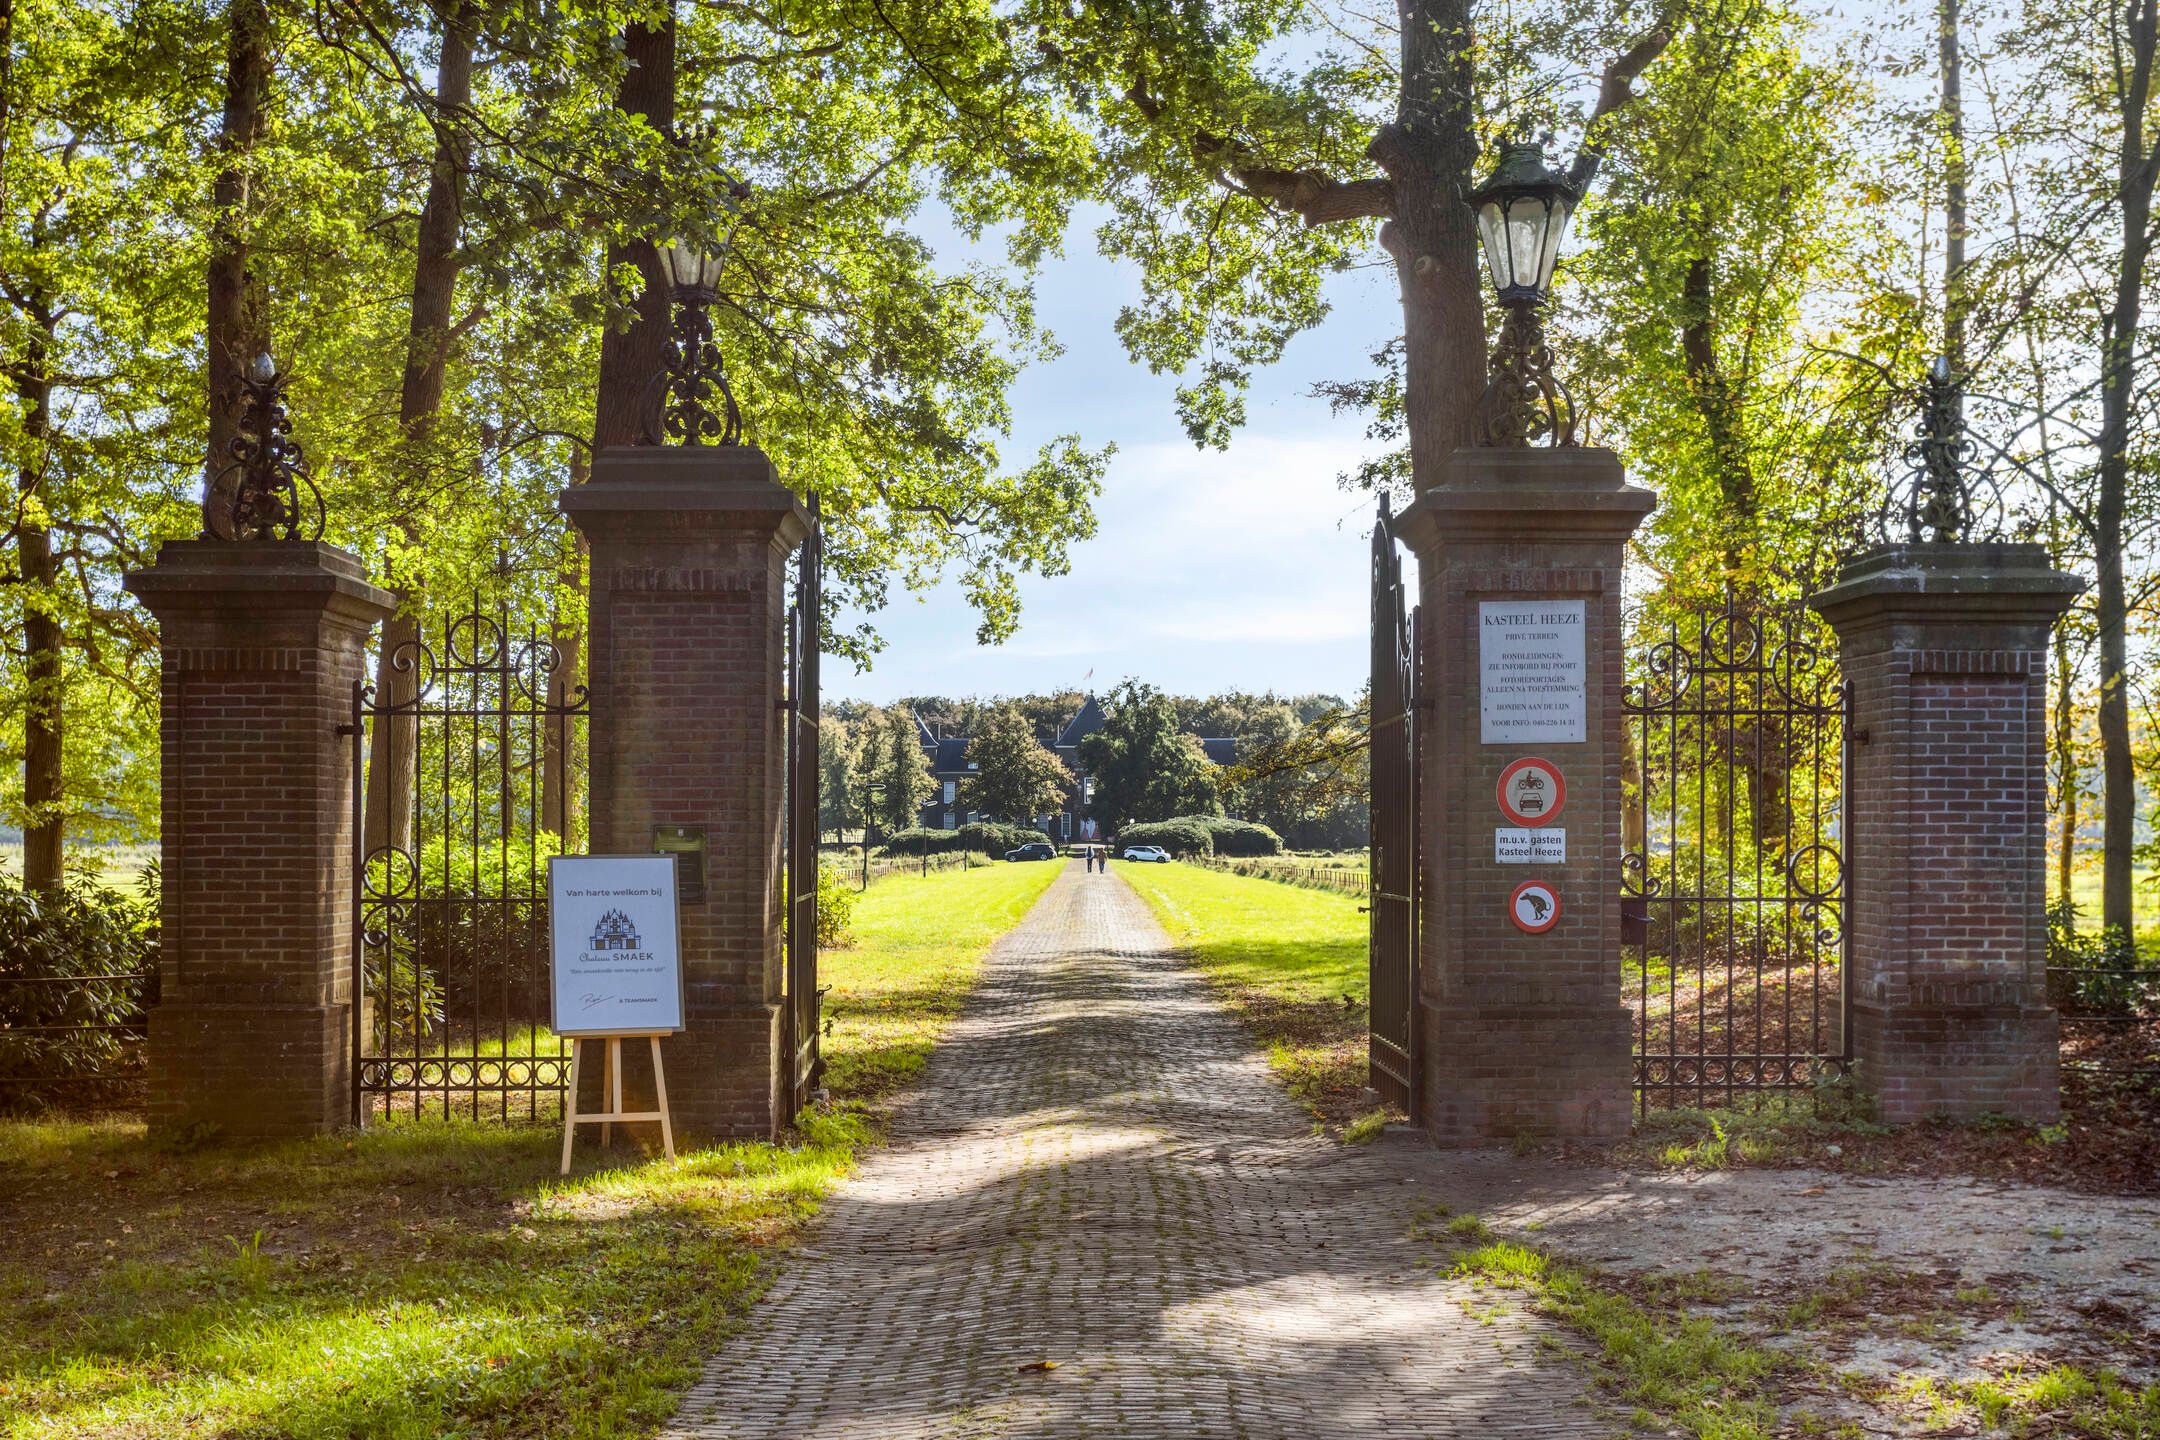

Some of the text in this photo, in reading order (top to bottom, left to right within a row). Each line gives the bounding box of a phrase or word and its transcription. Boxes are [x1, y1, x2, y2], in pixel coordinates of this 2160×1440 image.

[1485, 613, 1580, 626] KASTEEL HEEZE
[1528, 632, 1559, 640] TERREIN
[1488, 663, 1500, 671] ZIE
[1553, 662, 1577, 670] POORT
[1528, 685, 1580, 693] TOESTEMMING
[1491, 720, 1511, 728] VOOR
[1500, 836, 1561, 846] m.u.v. gasten
[1499, 847, 1562, 856] Kasteel Heeze
[566, 888, 662, 897] Van harte welkom bij
[612, 952, 654, 961] SMAEK
